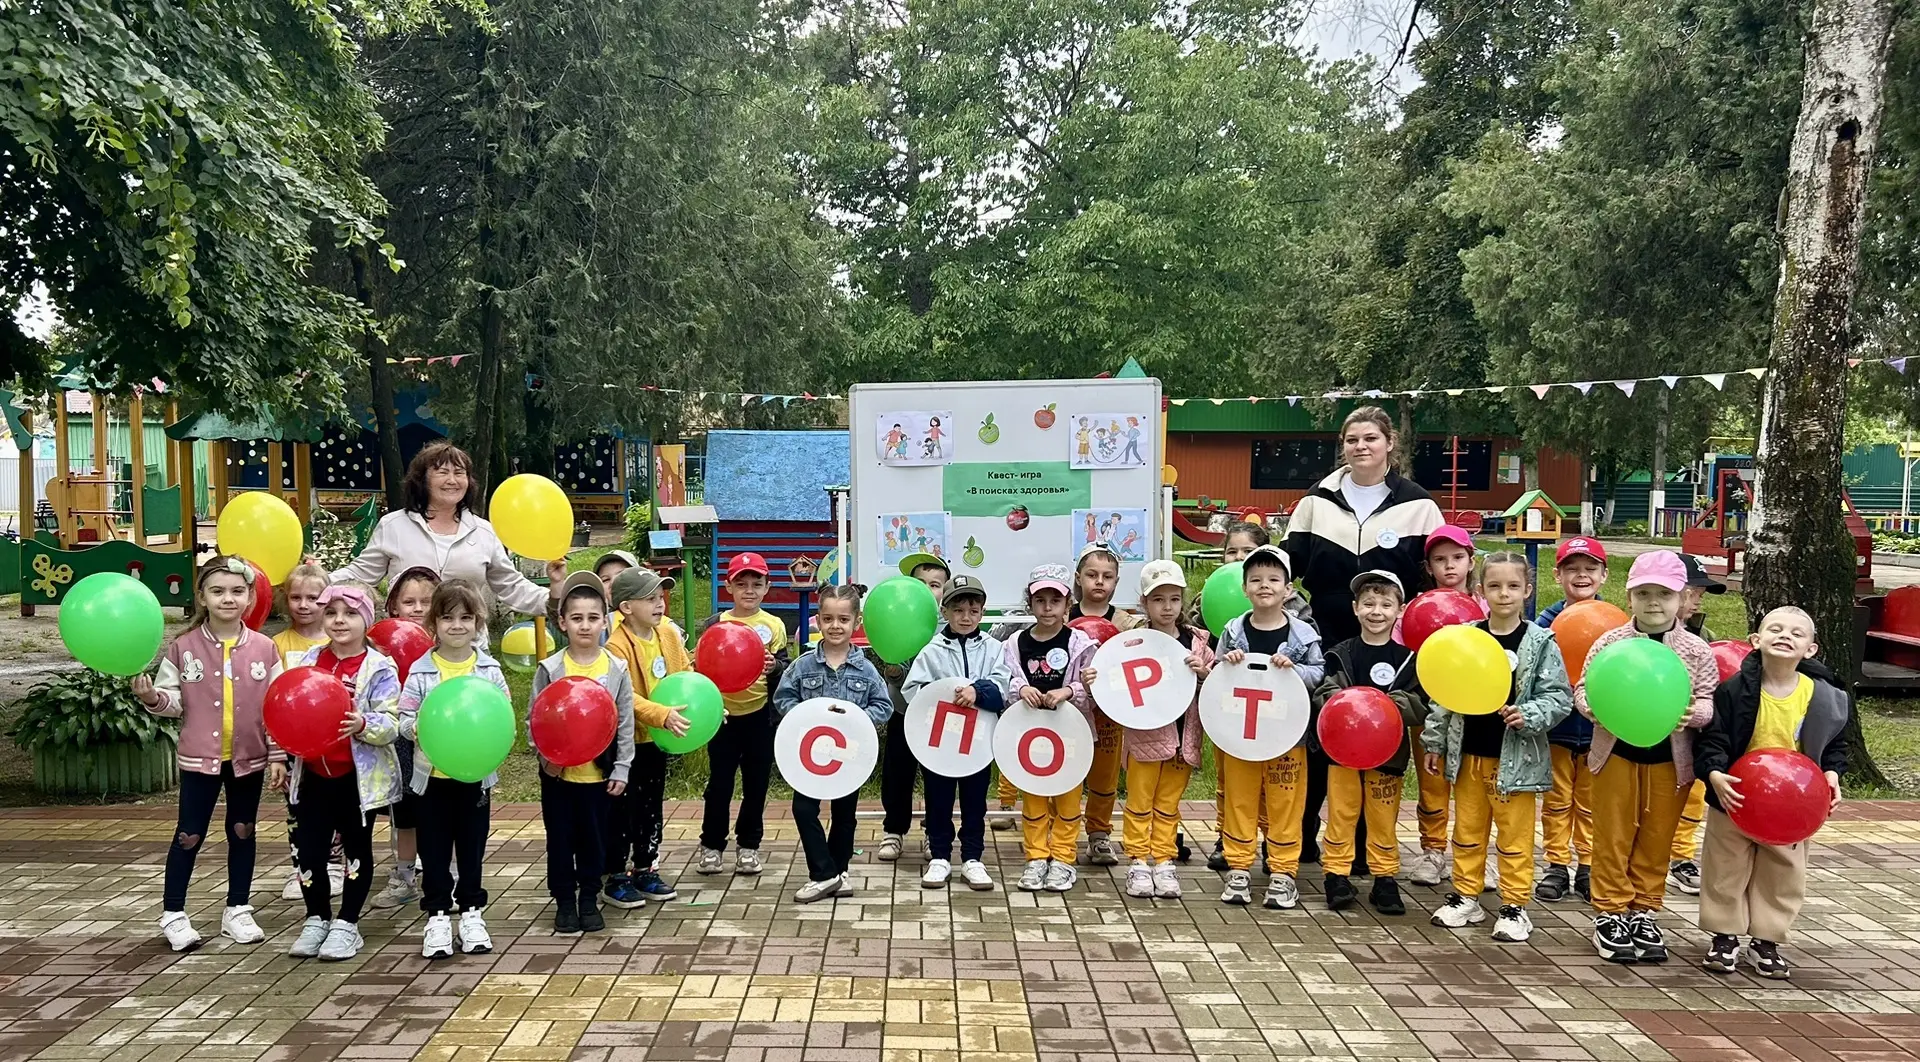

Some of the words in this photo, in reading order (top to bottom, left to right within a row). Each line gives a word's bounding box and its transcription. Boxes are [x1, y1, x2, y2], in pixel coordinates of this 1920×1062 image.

[966, 487, 977, 495] «В
[1020, 487, 1070, 495] здоровья»
[987, 471, 1018, 479] Квест-
[1020, 471, 1042, 480] игра
[1122, 658, 1163, 707] Р
[928, 700, 979, 755] П
[1233, 688, 1273, 740] Т
[799, 725, 847, 776] С
[1017, 728, 1065, 777] О
